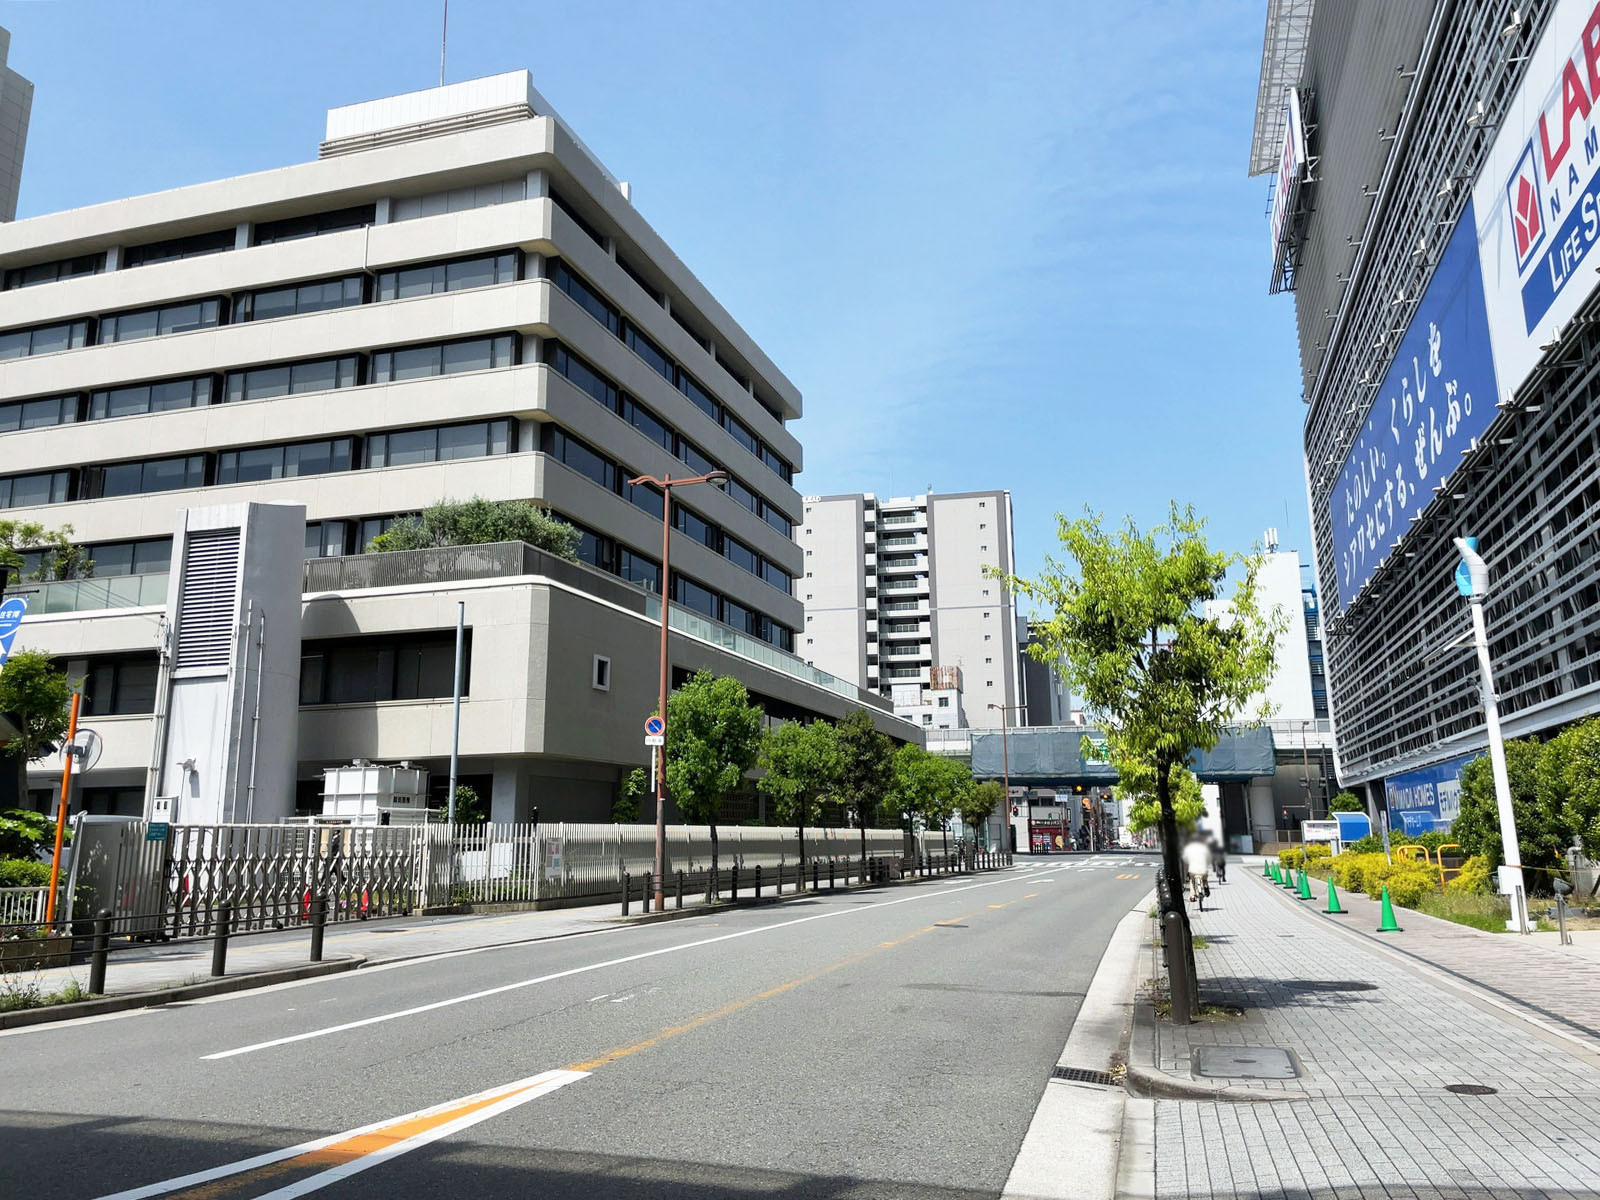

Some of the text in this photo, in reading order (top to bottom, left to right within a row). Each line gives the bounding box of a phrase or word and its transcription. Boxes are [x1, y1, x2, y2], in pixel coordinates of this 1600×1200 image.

[1548, 190, 1600, 293] LIFE S
[1413, 782, 1435, 808] HOMES
